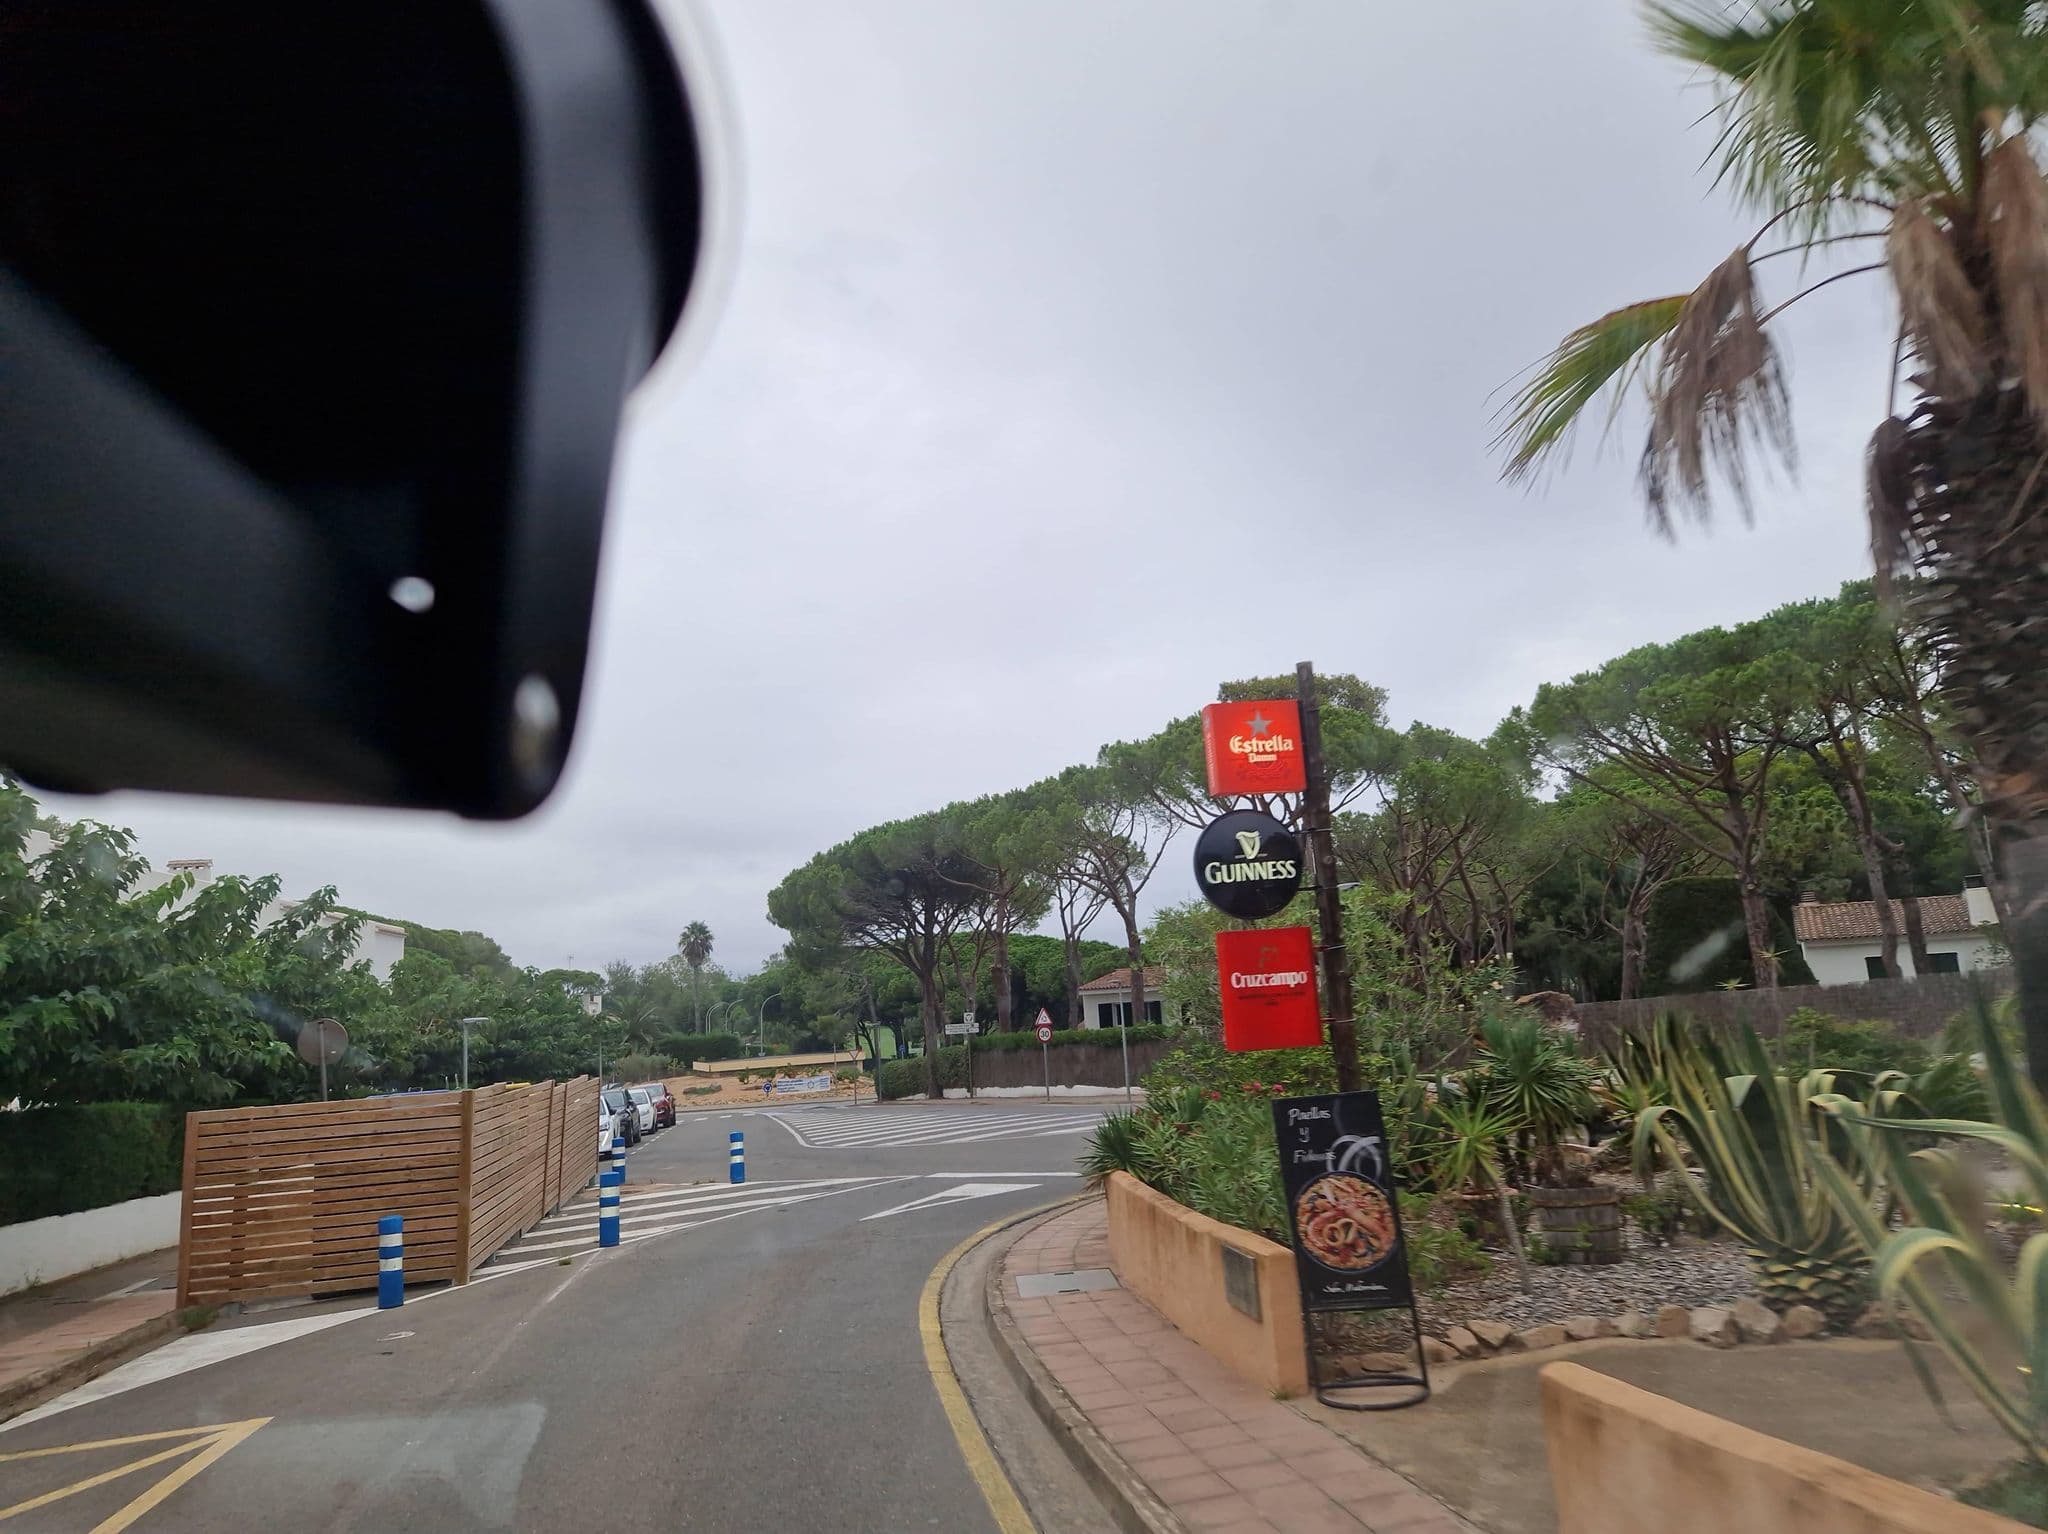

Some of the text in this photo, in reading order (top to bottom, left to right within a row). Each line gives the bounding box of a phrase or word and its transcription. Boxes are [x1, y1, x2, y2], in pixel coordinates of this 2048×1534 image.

[1229, 735, 1294, 753] Estrella
[1231, 972, 1307, 988] Cruzcampo
[1040, 1030, 1050, 1038] 30
